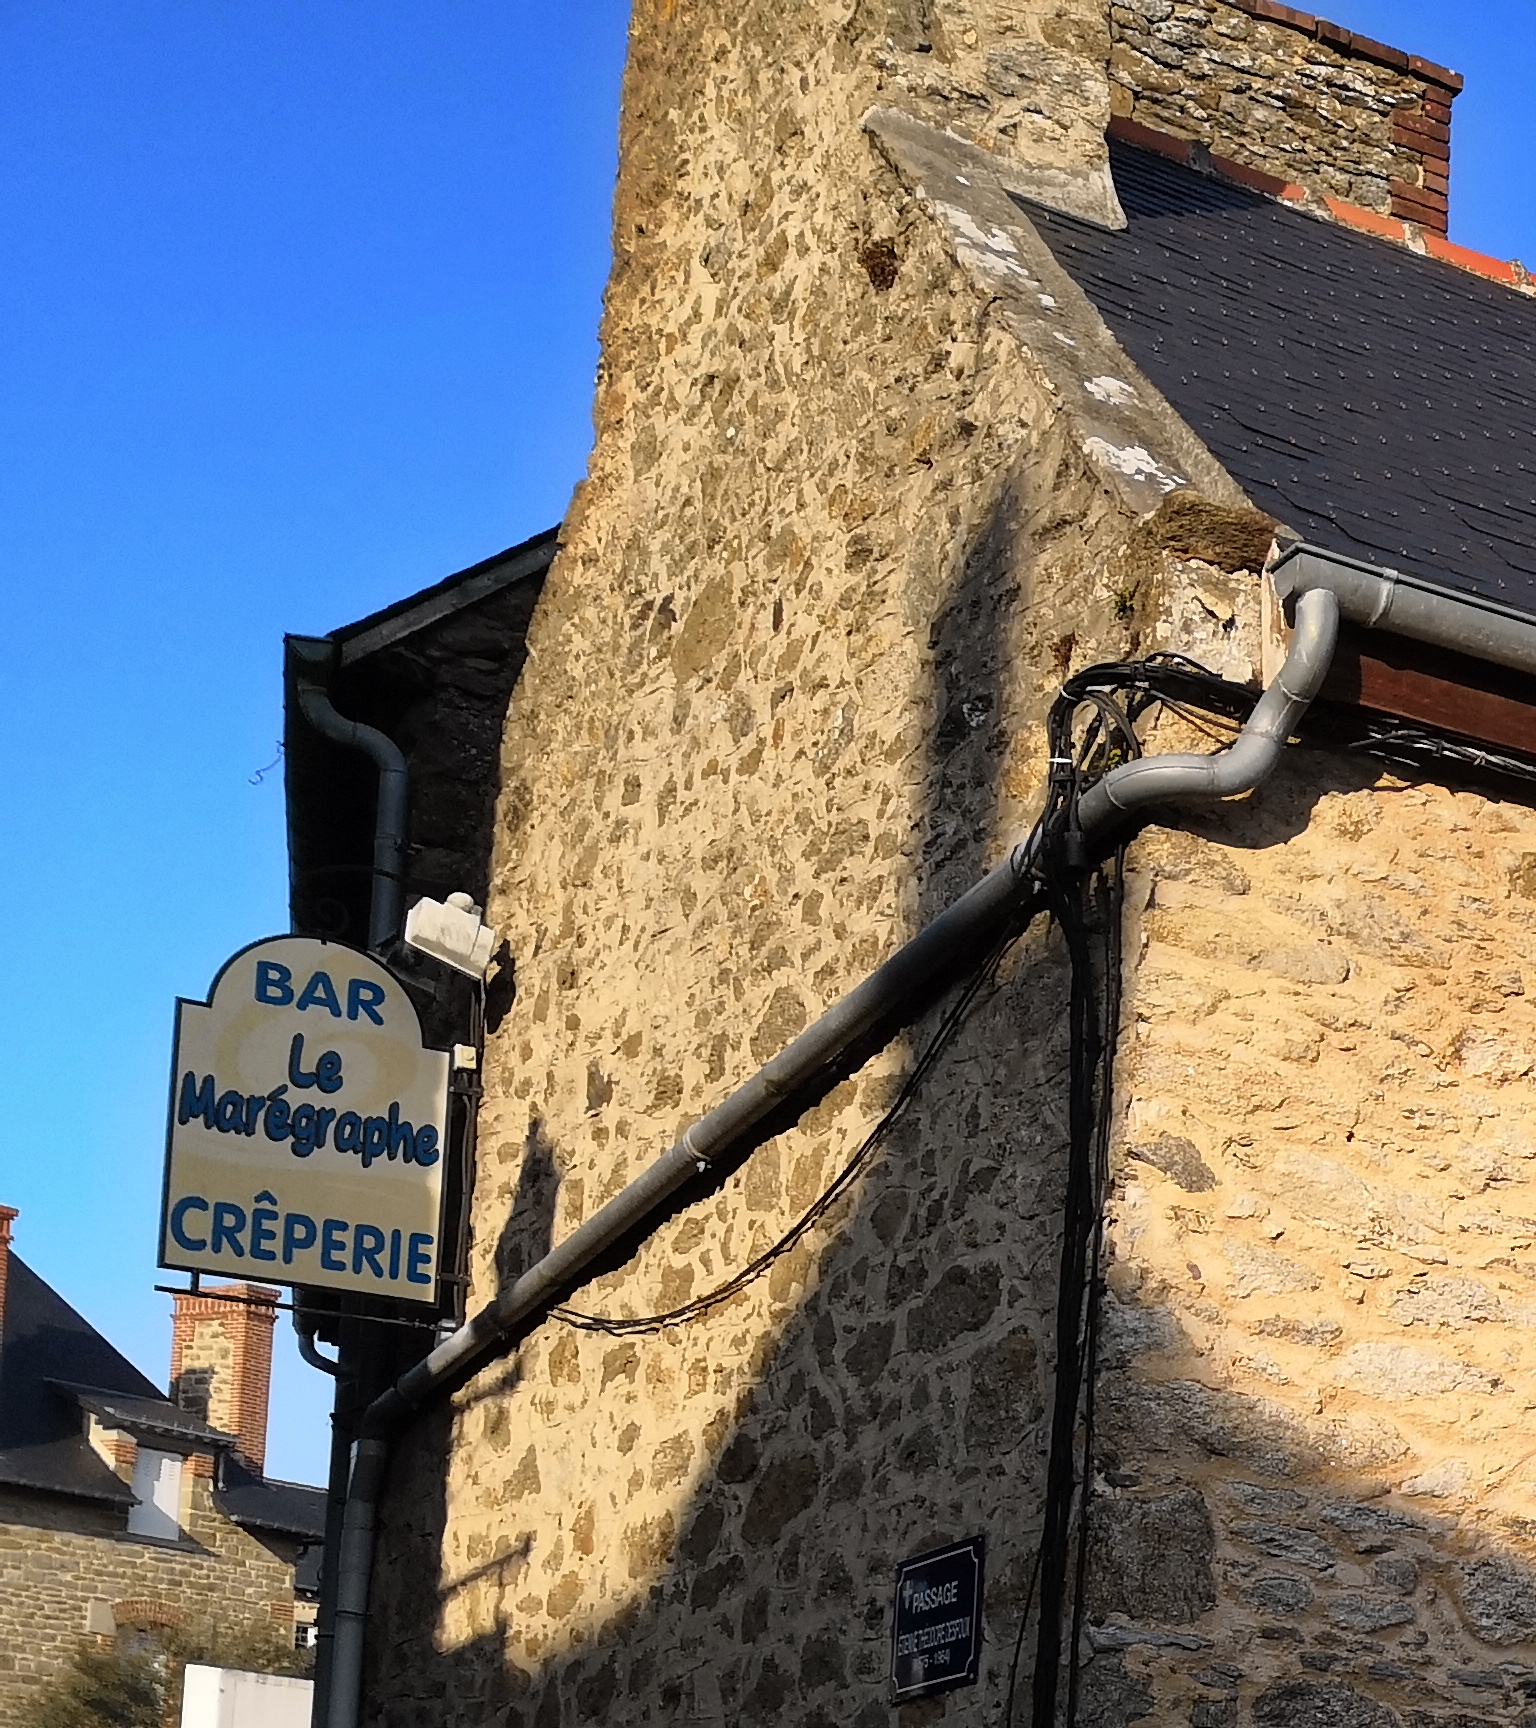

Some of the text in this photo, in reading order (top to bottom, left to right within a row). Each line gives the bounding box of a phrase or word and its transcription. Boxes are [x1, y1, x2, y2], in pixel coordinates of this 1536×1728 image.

[254, 960, 386, 1026] BAR
[288, 1033, 343, 1094] Le
[177, 1071, 440, 1168] Marégraphe
[170, 1190, 435, 1285] CRÊPERIE
[912, 1581, 959, 1614] PASSAGE
